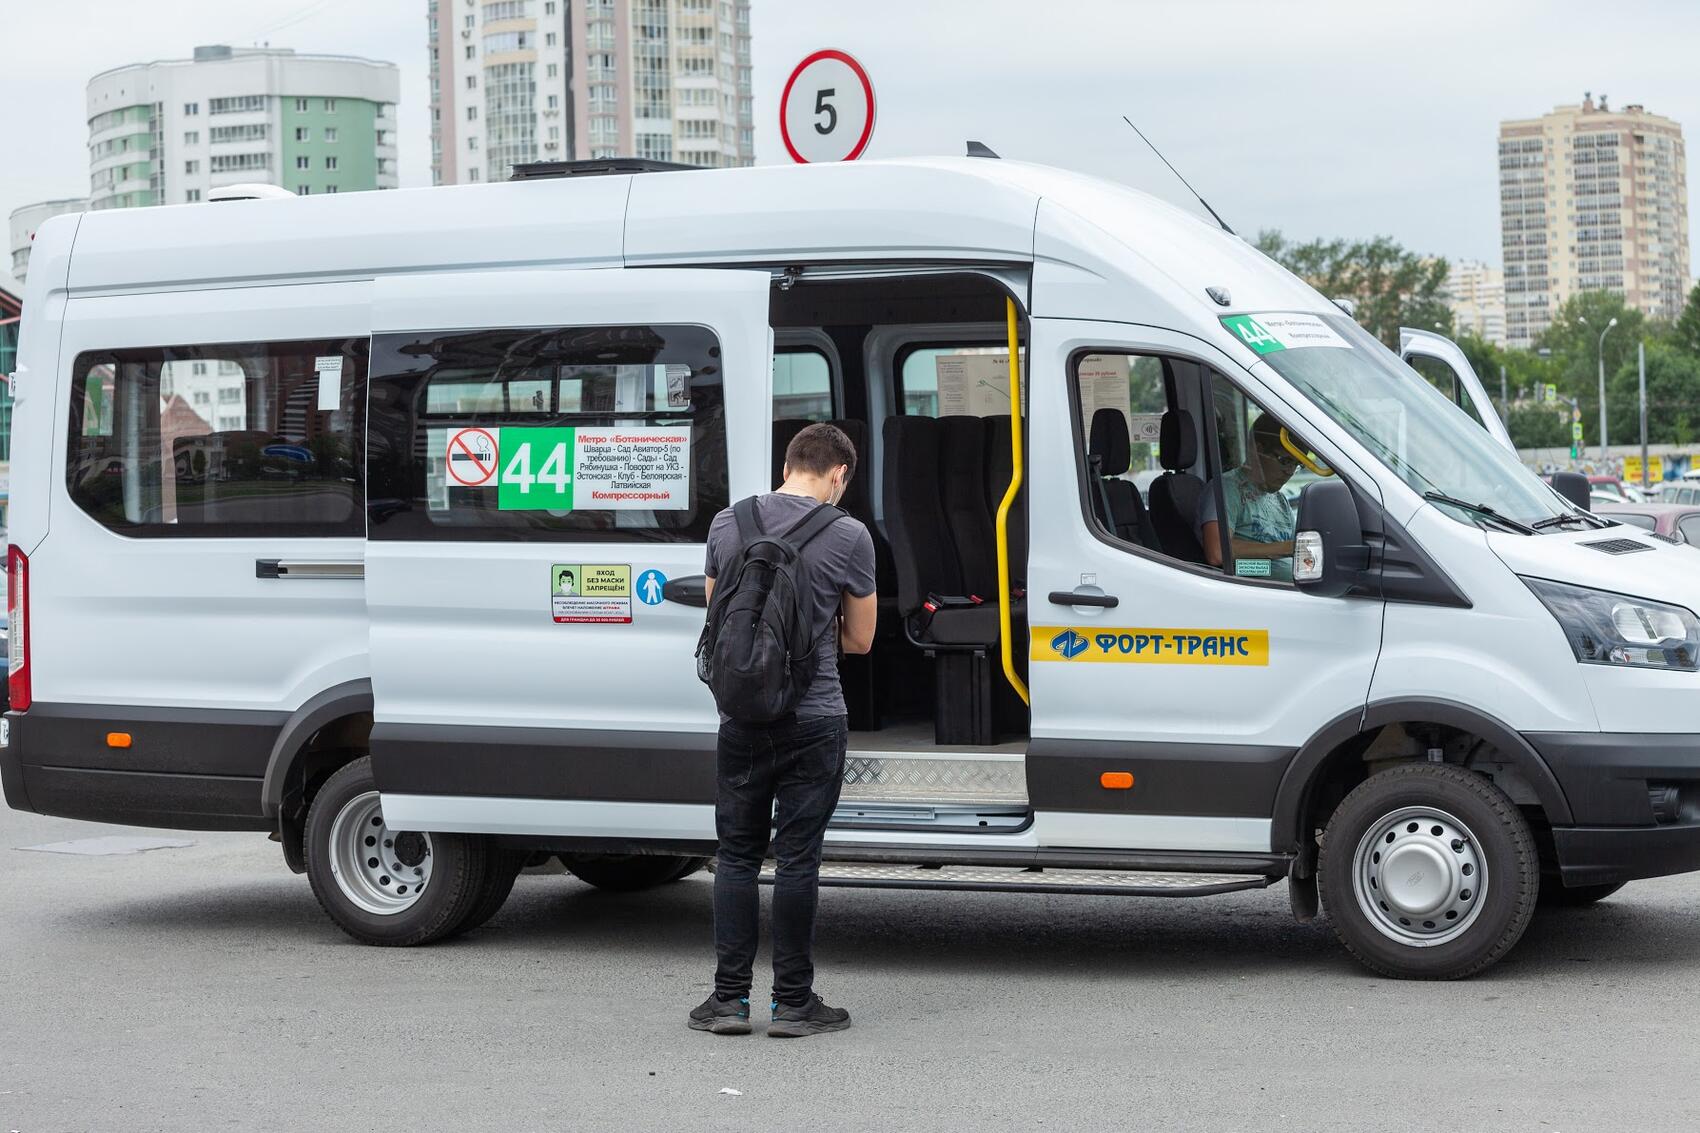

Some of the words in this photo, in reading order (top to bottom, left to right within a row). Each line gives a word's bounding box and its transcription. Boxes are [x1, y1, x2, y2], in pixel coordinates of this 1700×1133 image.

[814, 87, 838, 135] 5
[1236, 322, 1277, 346] 44
[578, 435, 607, 445] Метро
[609, 434, 688, 444] «Ботаническая»
[583, 444, 612, 455] Шварца
[617, 444, 632, 455] Сад
[632, 444, 669, 455] Авиатор-5
[670, 444, 681, 455] (по
[586, 454, 632, 464] требованию)
[637, 453, 658, 463] Сады
[663, 453, 678, 463] Сад
[501, 442, 572, 494] 44
[579, 462, 619, 473] Рябинушка
[624, 462, 655, 473] Поворот
[576, 471, 613, 481] Эстонская
[617, 471, 636, 482] Клуб
[641, 472, 683, 482] Белоярская
[610, 480, 652, 490] Латвийская
[592, 490, 671, 502] Компрессорный
[1095, 634, 1250, 657] ФОРТ-ТРАНС
